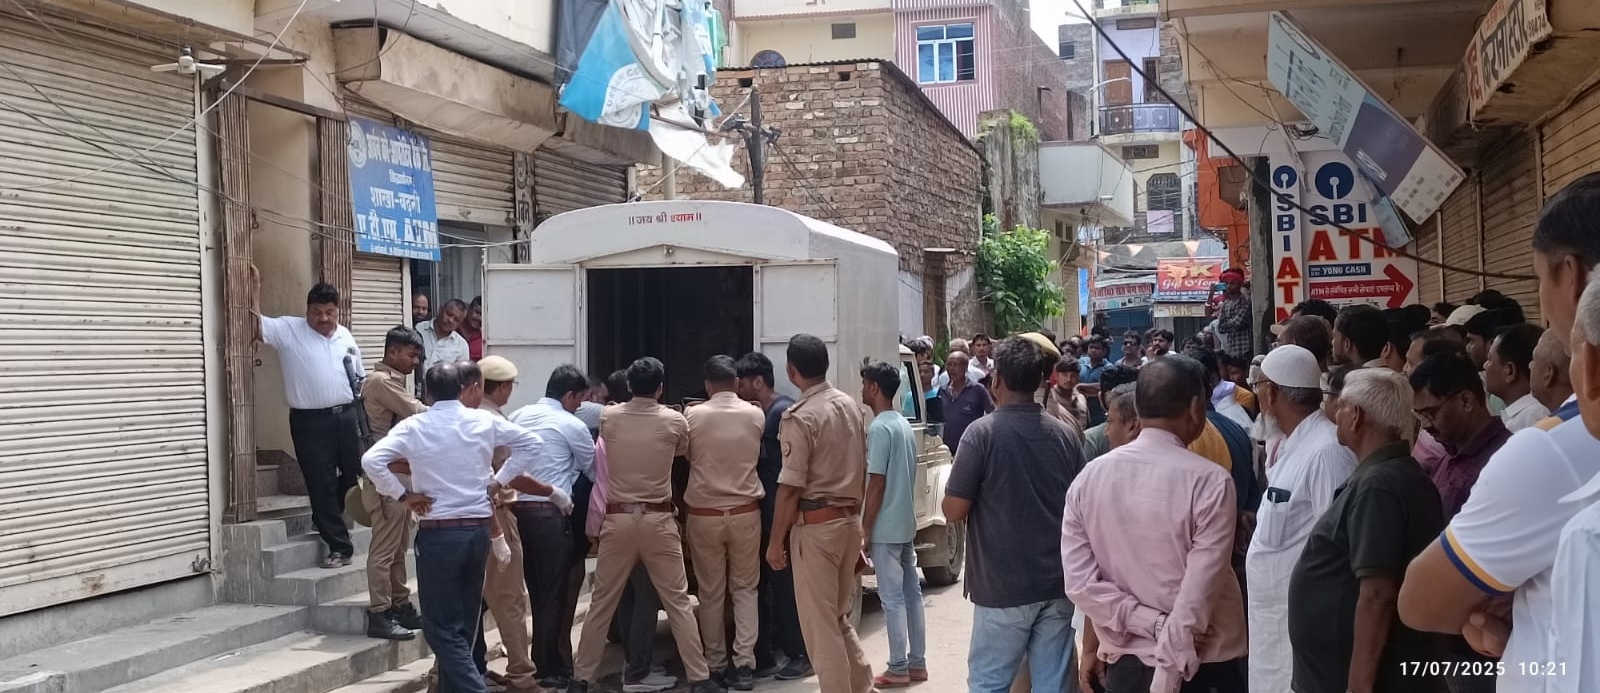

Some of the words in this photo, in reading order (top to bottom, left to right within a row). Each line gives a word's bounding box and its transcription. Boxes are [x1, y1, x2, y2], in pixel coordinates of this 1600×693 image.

[655, 211, 668, 223] श्री
[1308, 202, 1367, 226] SBI
[1276, 193, 1296, 252] SBI
[1322, 266, 1343, 275] YONO
[1345, 265, 1366, 274] CASH
[1311, 287, 1325, 296] ATM
